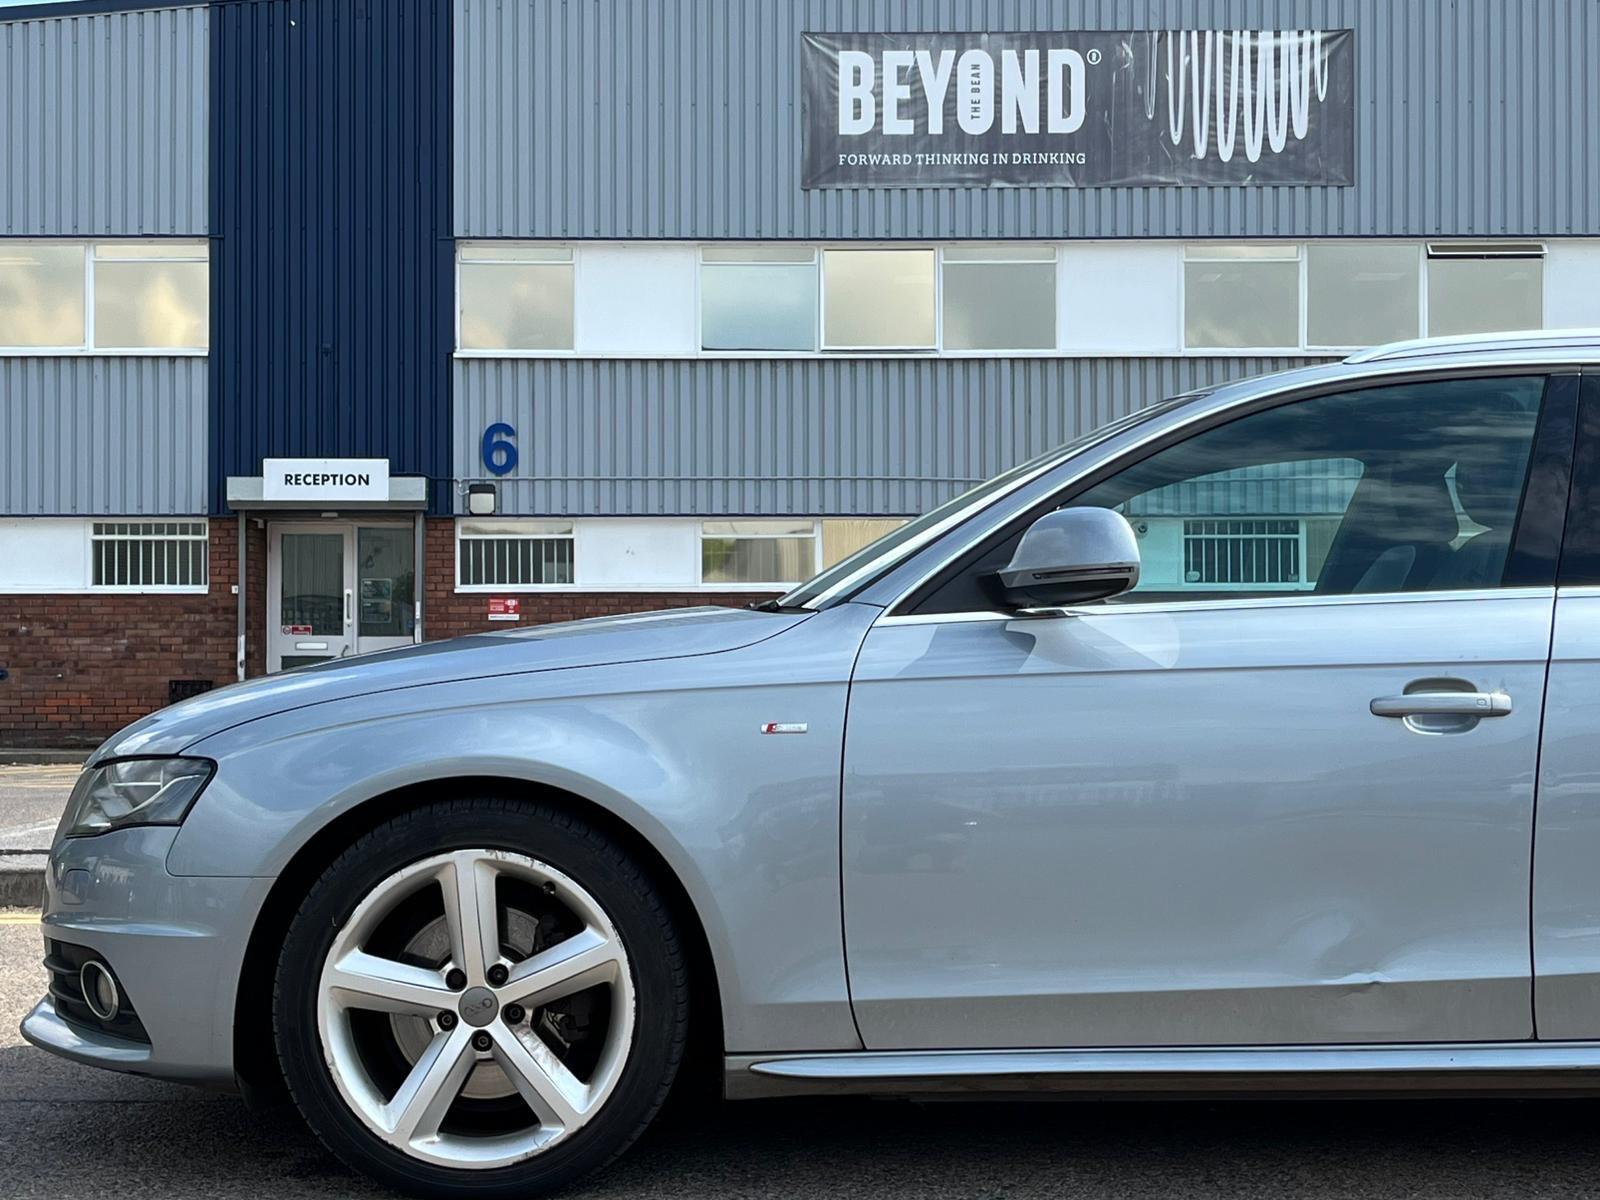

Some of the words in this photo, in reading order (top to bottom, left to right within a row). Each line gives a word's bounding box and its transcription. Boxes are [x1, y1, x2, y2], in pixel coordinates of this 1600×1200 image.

[970, 64, 981, 94] BEAN
[838, 49, 1086, 135] BEYOND
[970, 99, 981, 120] THE
[838, 153, 912, 166] FORWARD
[915, 153, 989, 165] THINKING
[992, 153, 1009, 165] IN
[1012, 152, 1086, 165] DRINKING
[482, 422, 519, 475] 6
[284, 473, 370, 486] RECEPTION
